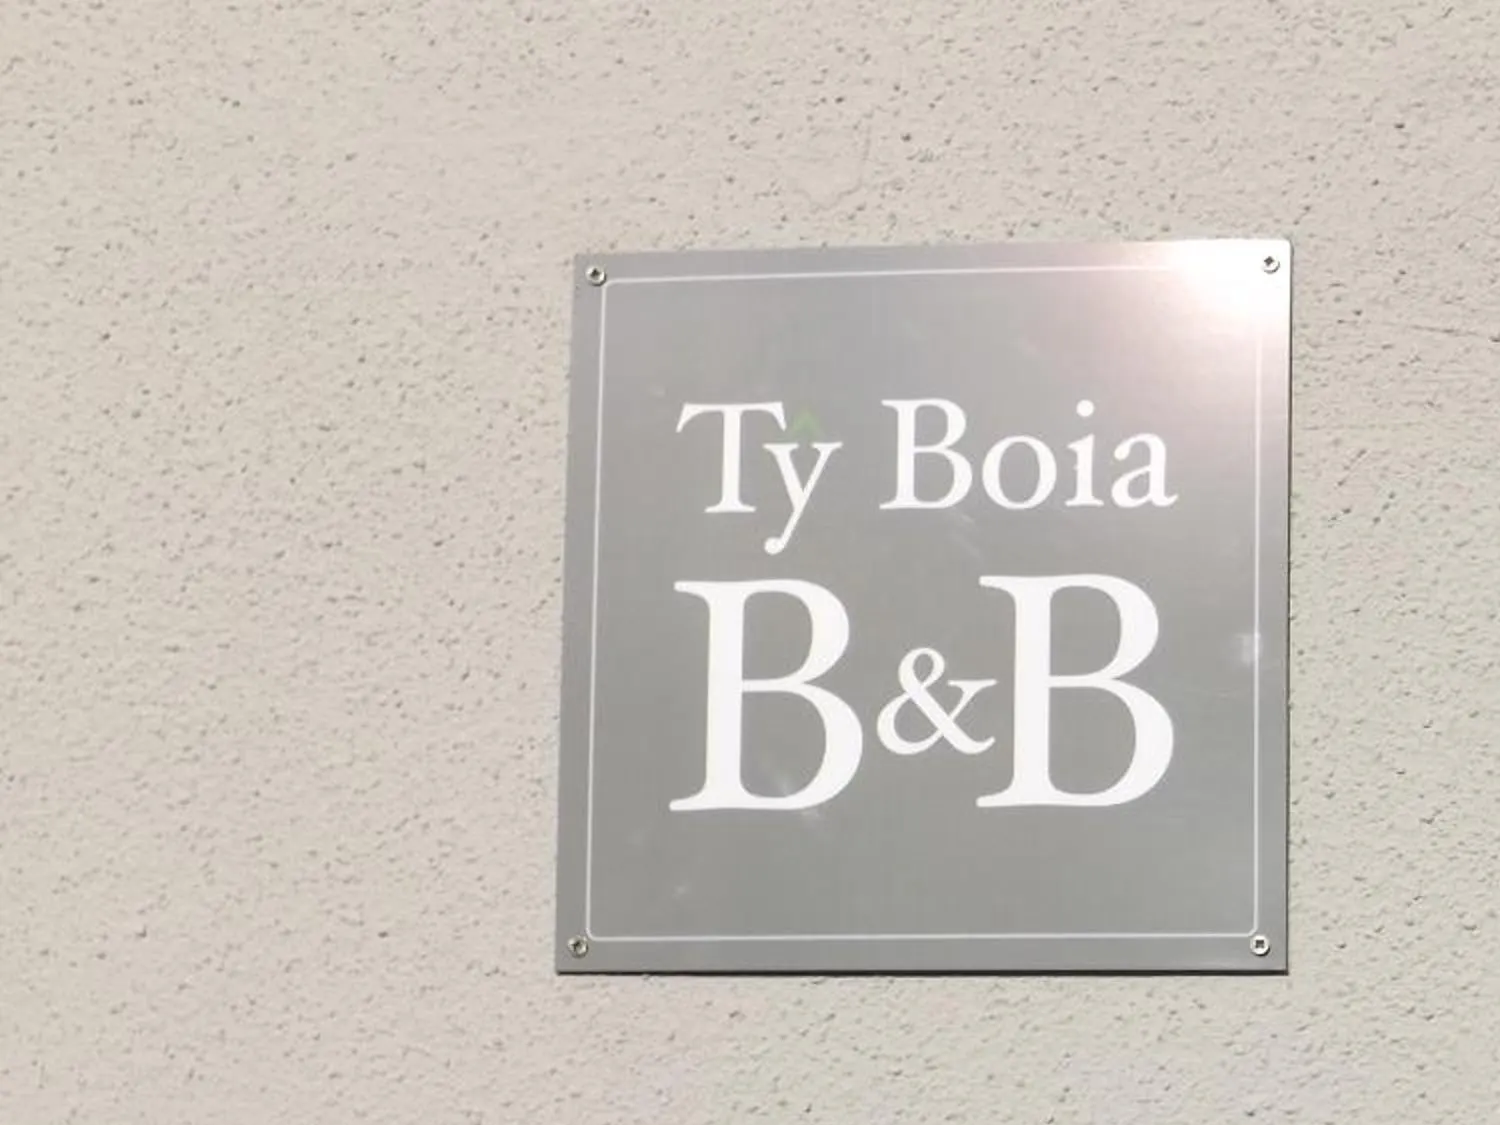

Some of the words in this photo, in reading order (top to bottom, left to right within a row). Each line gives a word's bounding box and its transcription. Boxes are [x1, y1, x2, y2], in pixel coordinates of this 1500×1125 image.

[675, 401, 843, 555] Ty
[879, 397, 1178, 510] Boia
[669, 573, 1175, 811] B&B
